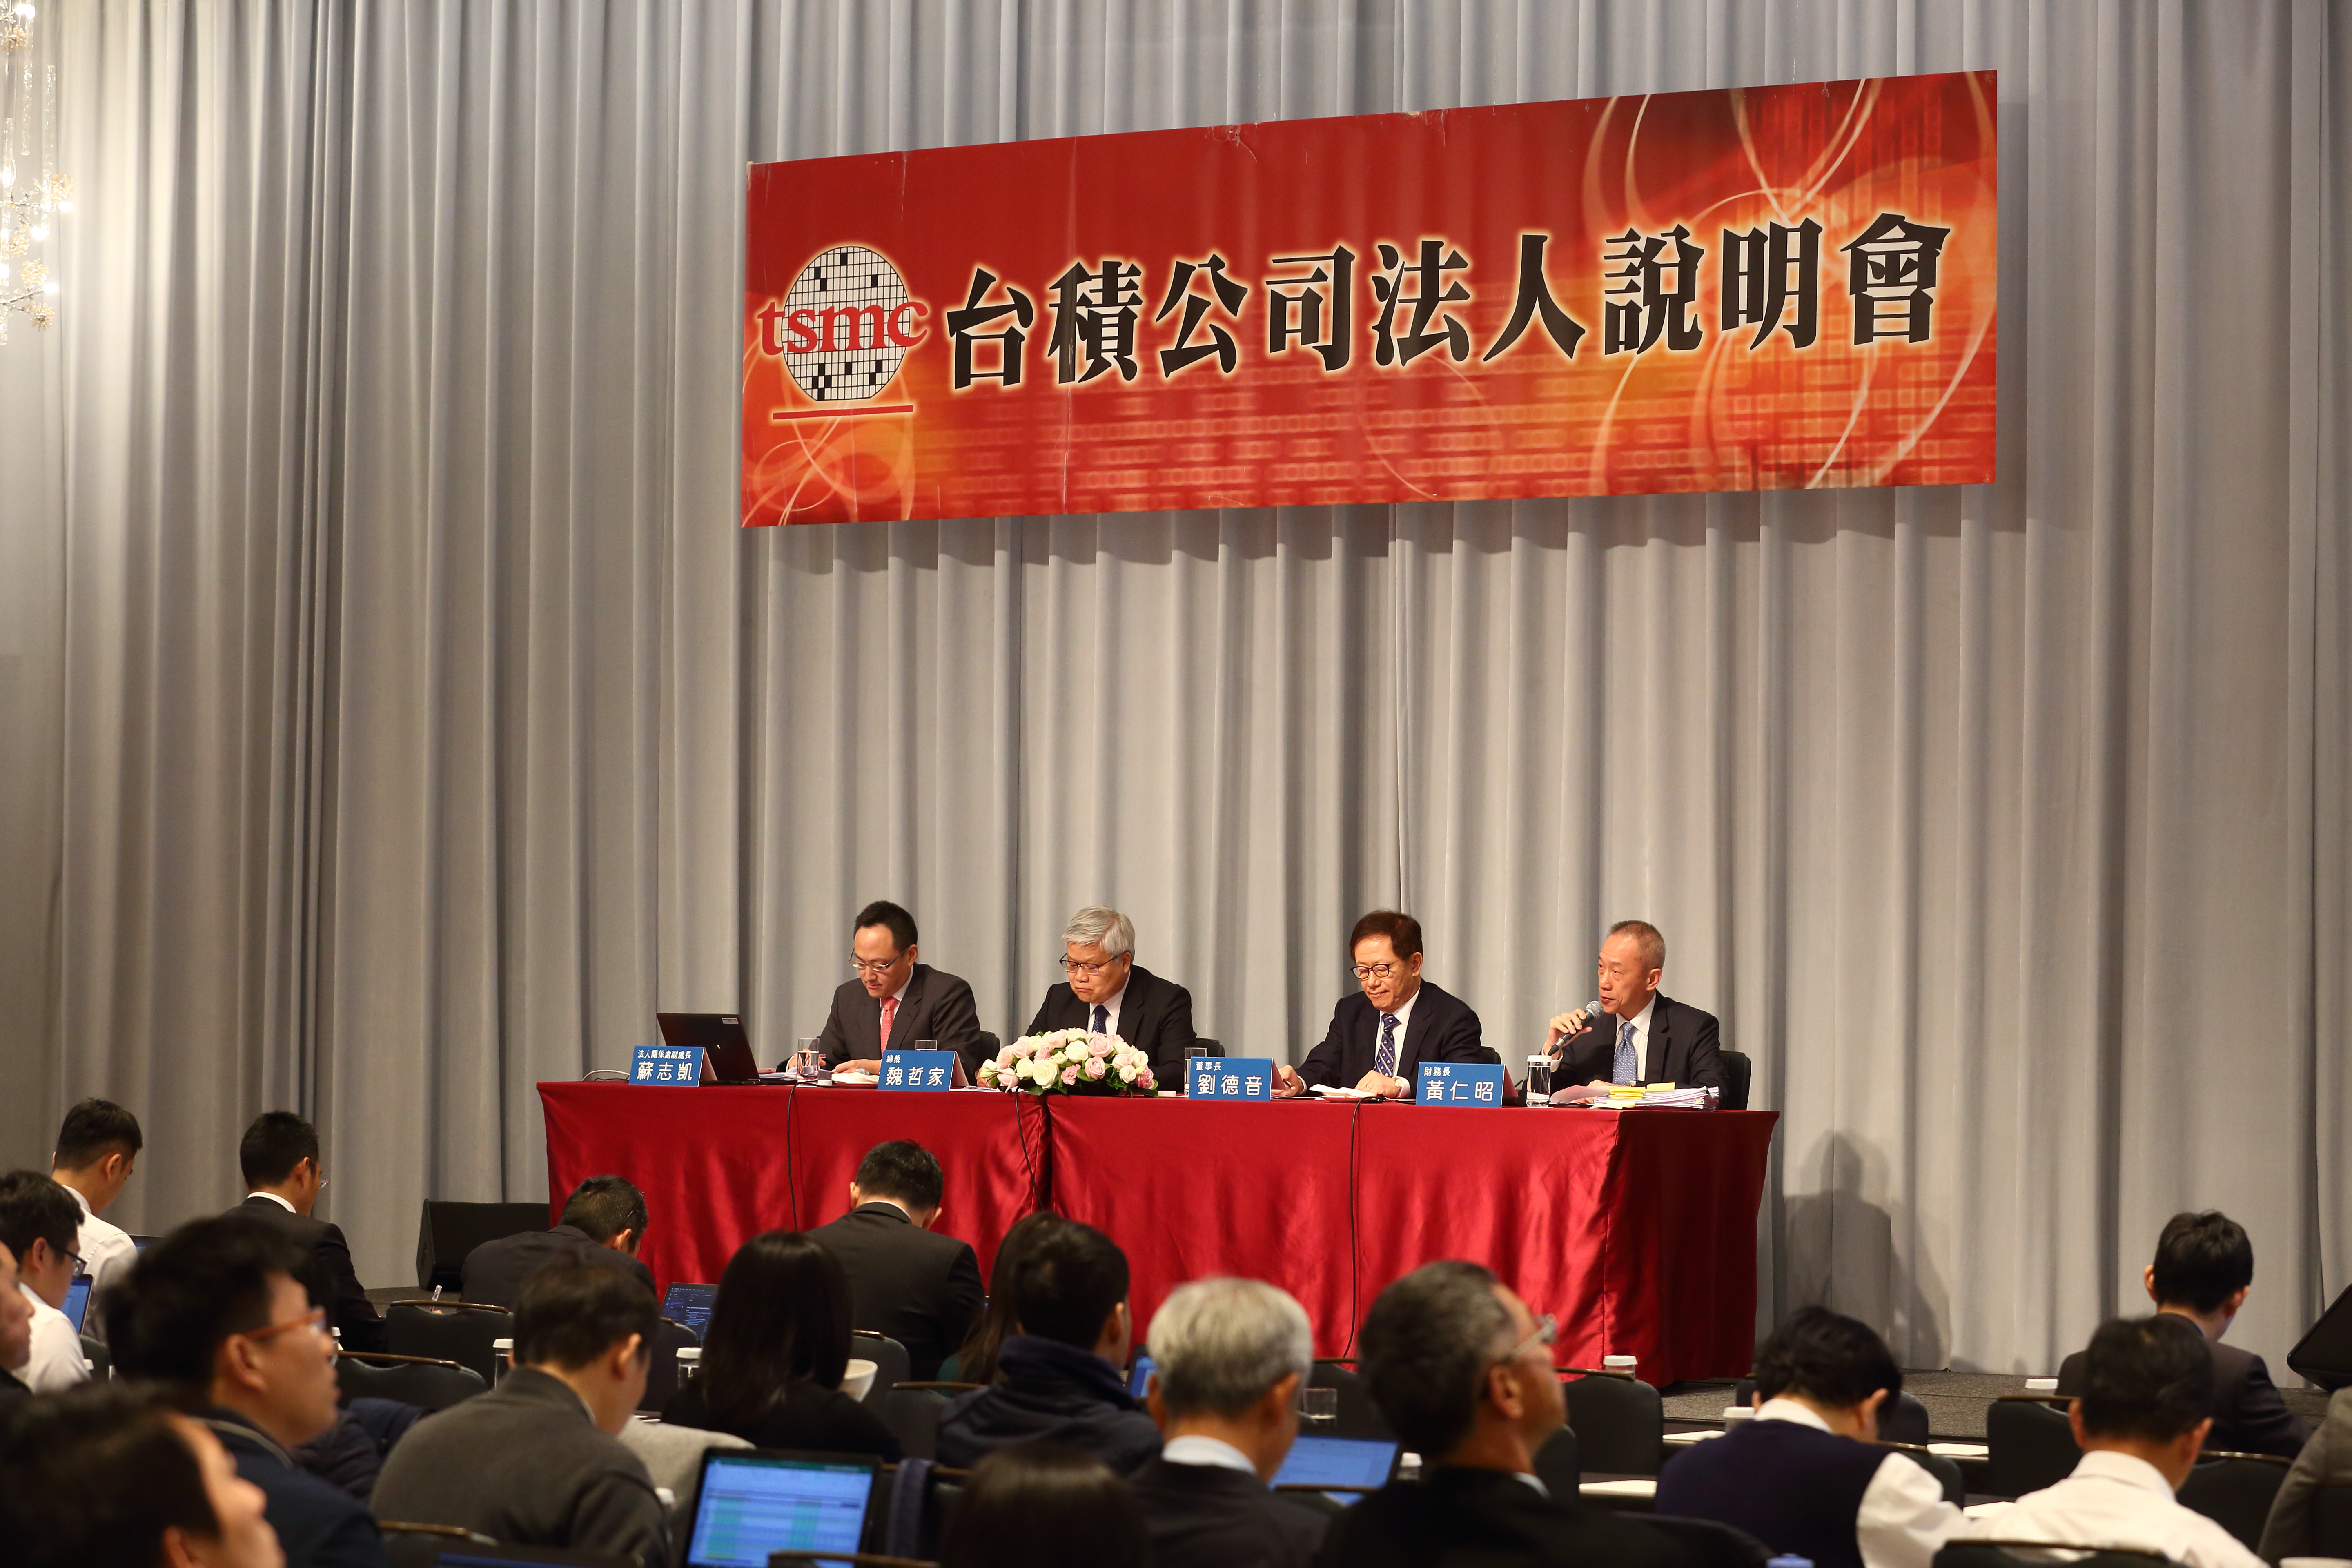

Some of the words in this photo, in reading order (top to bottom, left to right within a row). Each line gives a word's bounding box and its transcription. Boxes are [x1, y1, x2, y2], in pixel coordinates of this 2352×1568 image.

[947, 213, 1951, 389] 台積公司法人說明會
[758, 301, 928, 355] tsmc
[637, 1049, 691, 1060] 法人關係處副處長
[886, 1054, 901, 1063] 總裁
[636, 1061, 692, 1081] 蘇志凱
[885, 1066, 945, 1086] 魏哲家
[1195, 1061, 1221, 1071] 董事長
[1423, 1067, 1450, 1077] 財務長
[1198, 1074, 1263, 1096] 劉德音
[1426, 1080, 1494, 1102] 黃仁昭
